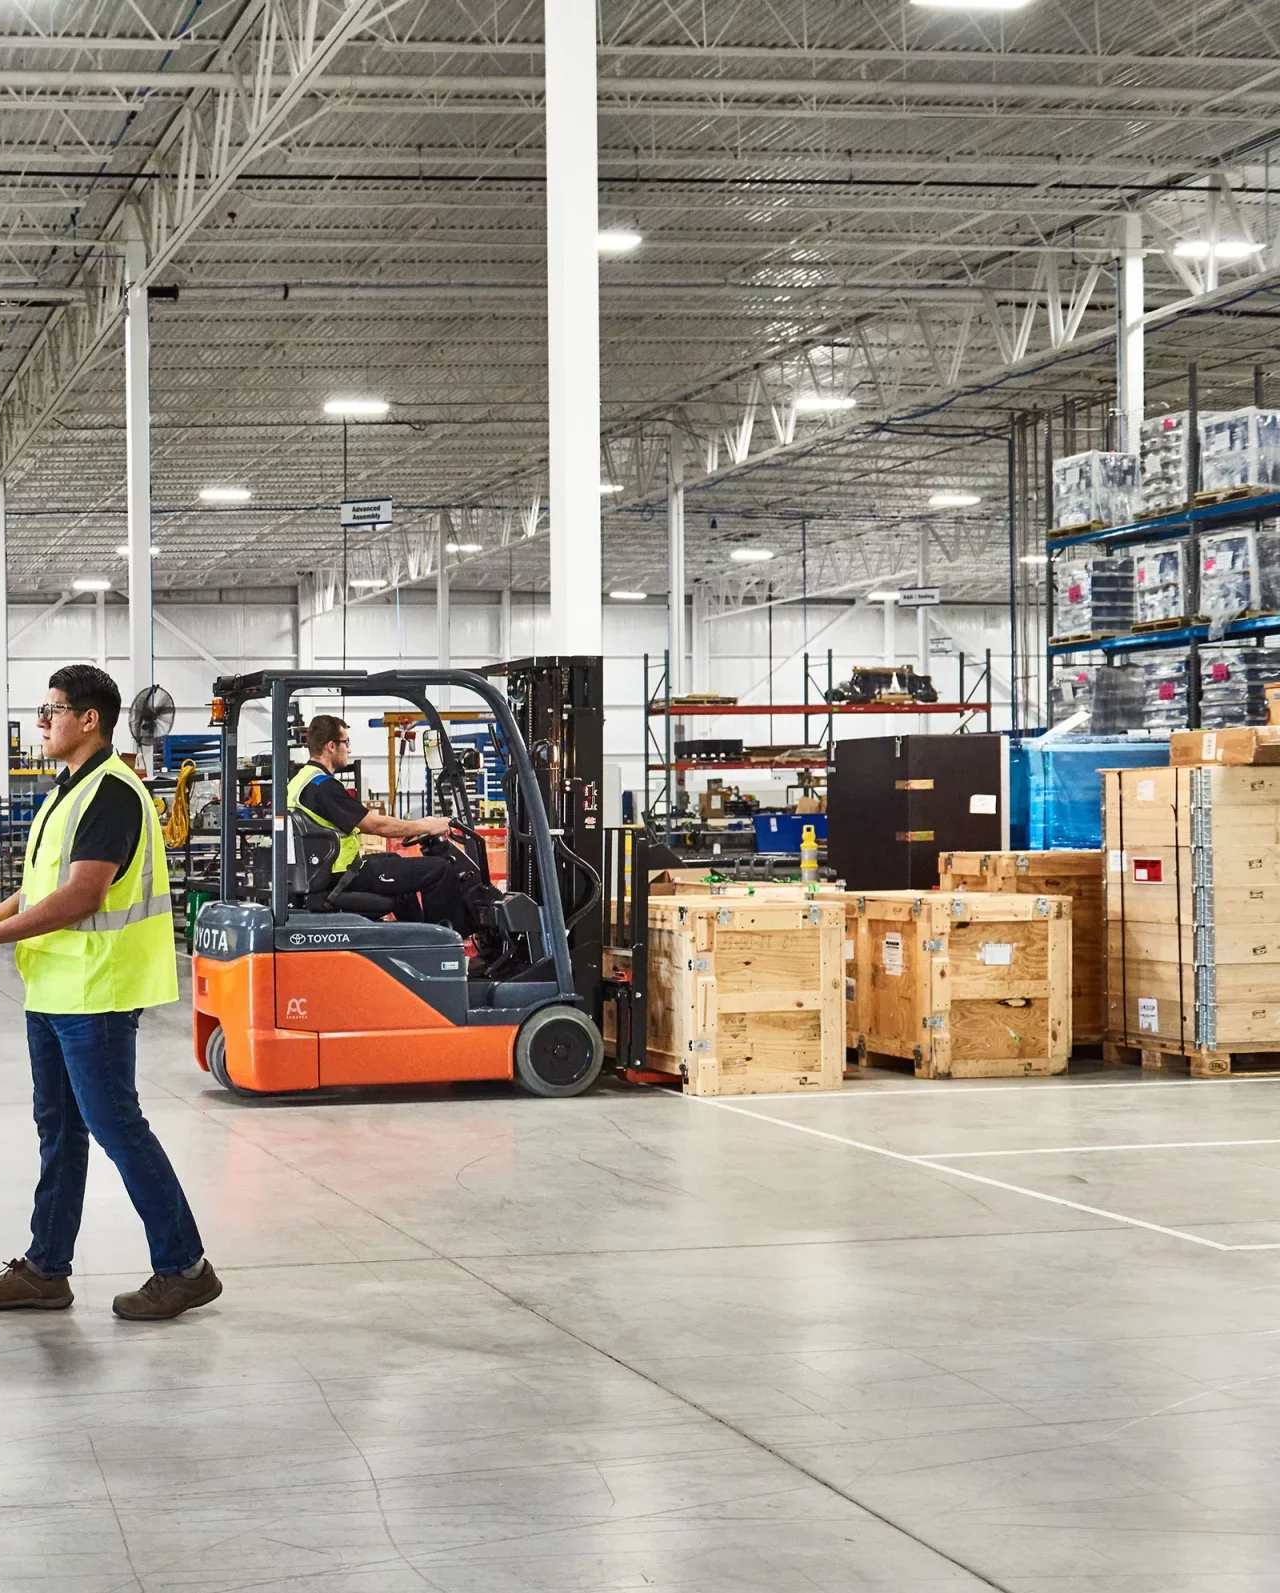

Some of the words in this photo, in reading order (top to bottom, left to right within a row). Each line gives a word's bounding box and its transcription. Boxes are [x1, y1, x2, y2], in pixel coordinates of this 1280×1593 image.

[352, 505, 381, 513] Advanced
[195, 926, 228, 952] OYOTA
[307, 933, 350, 943] TOYOTA
